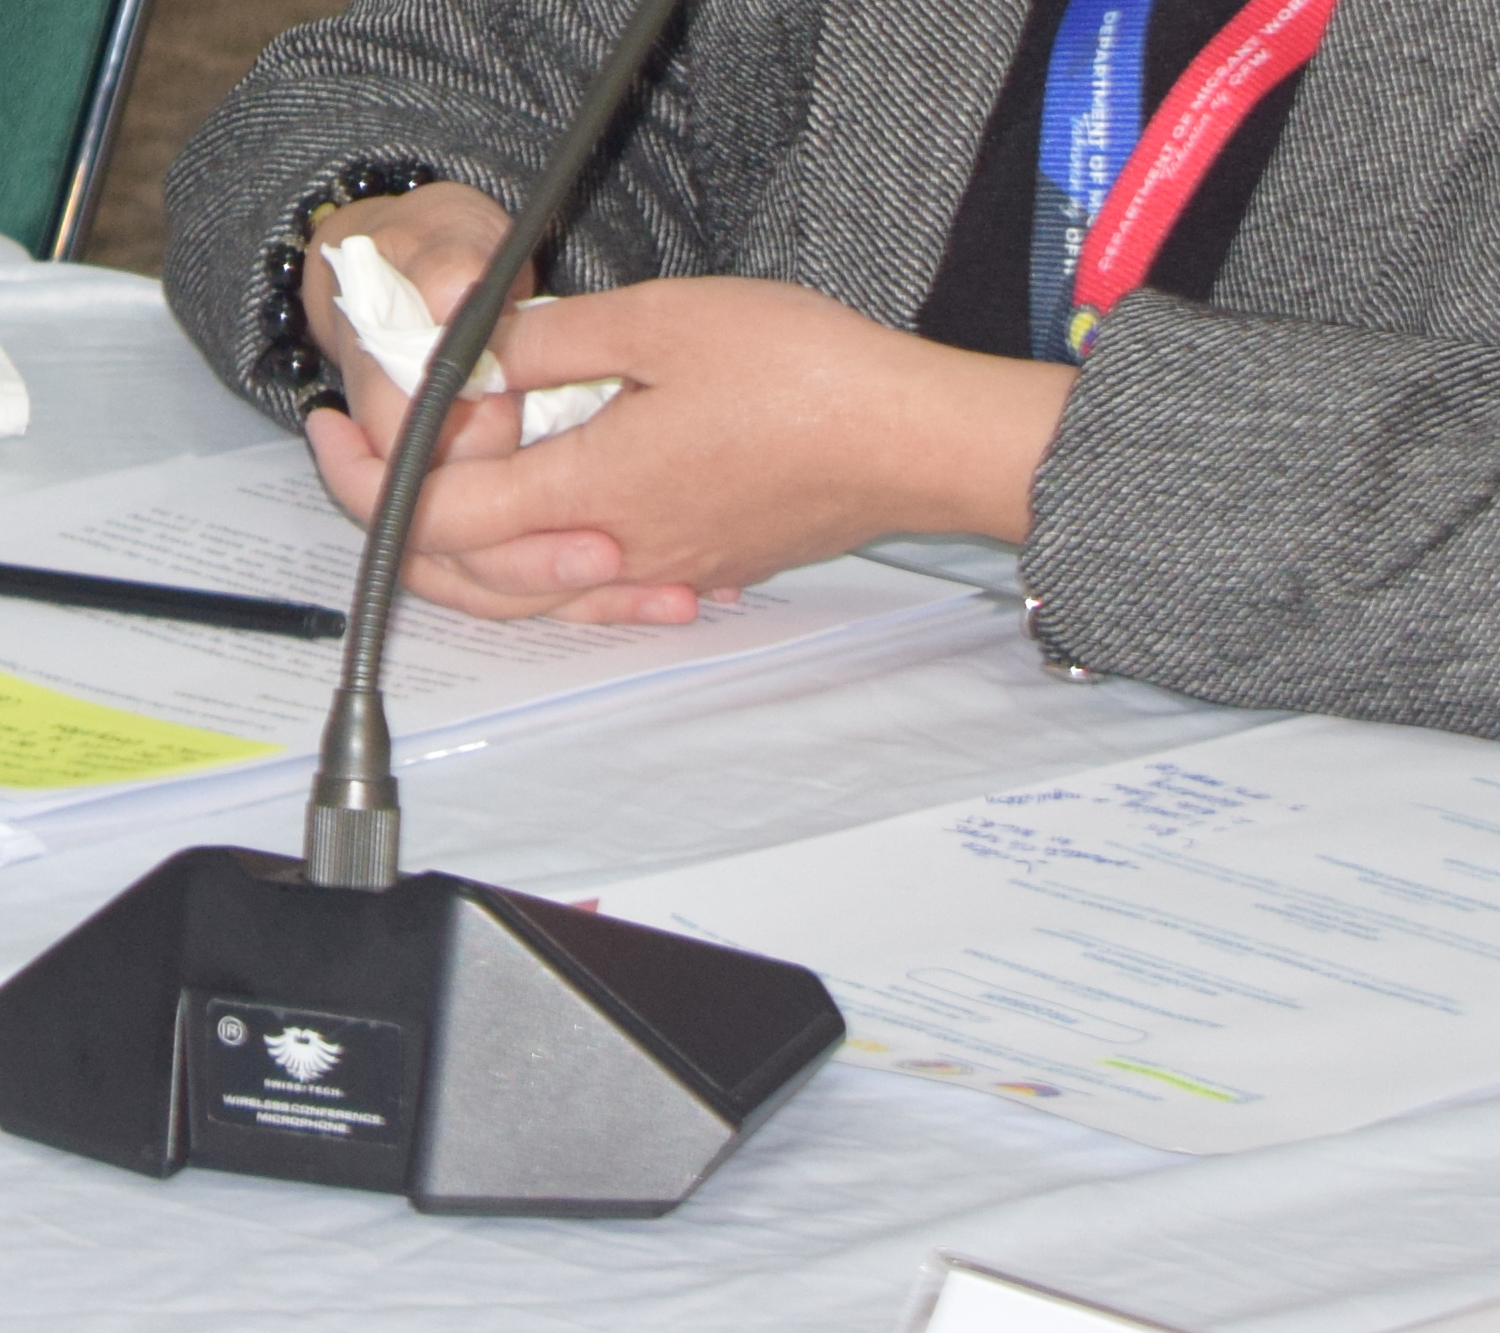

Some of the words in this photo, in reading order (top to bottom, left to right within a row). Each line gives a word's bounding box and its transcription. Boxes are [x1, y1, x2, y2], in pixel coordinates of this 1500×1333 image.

[1090, 10, 1121, 150] DEPARTMENT
[1089, 154, 1108, 186] OF
[1098, 140, 1176, 272] DEPARTMENT
[1172, 111, 1194, 139] OF
[1190, 35, 1261, 110] MIGRANT
[222, 1093, 290, 1112] WIRELESS
[290, 1100, 387, 1126] CONFERENCE
[255, 1111, 352, 1135] MICROPHONE
